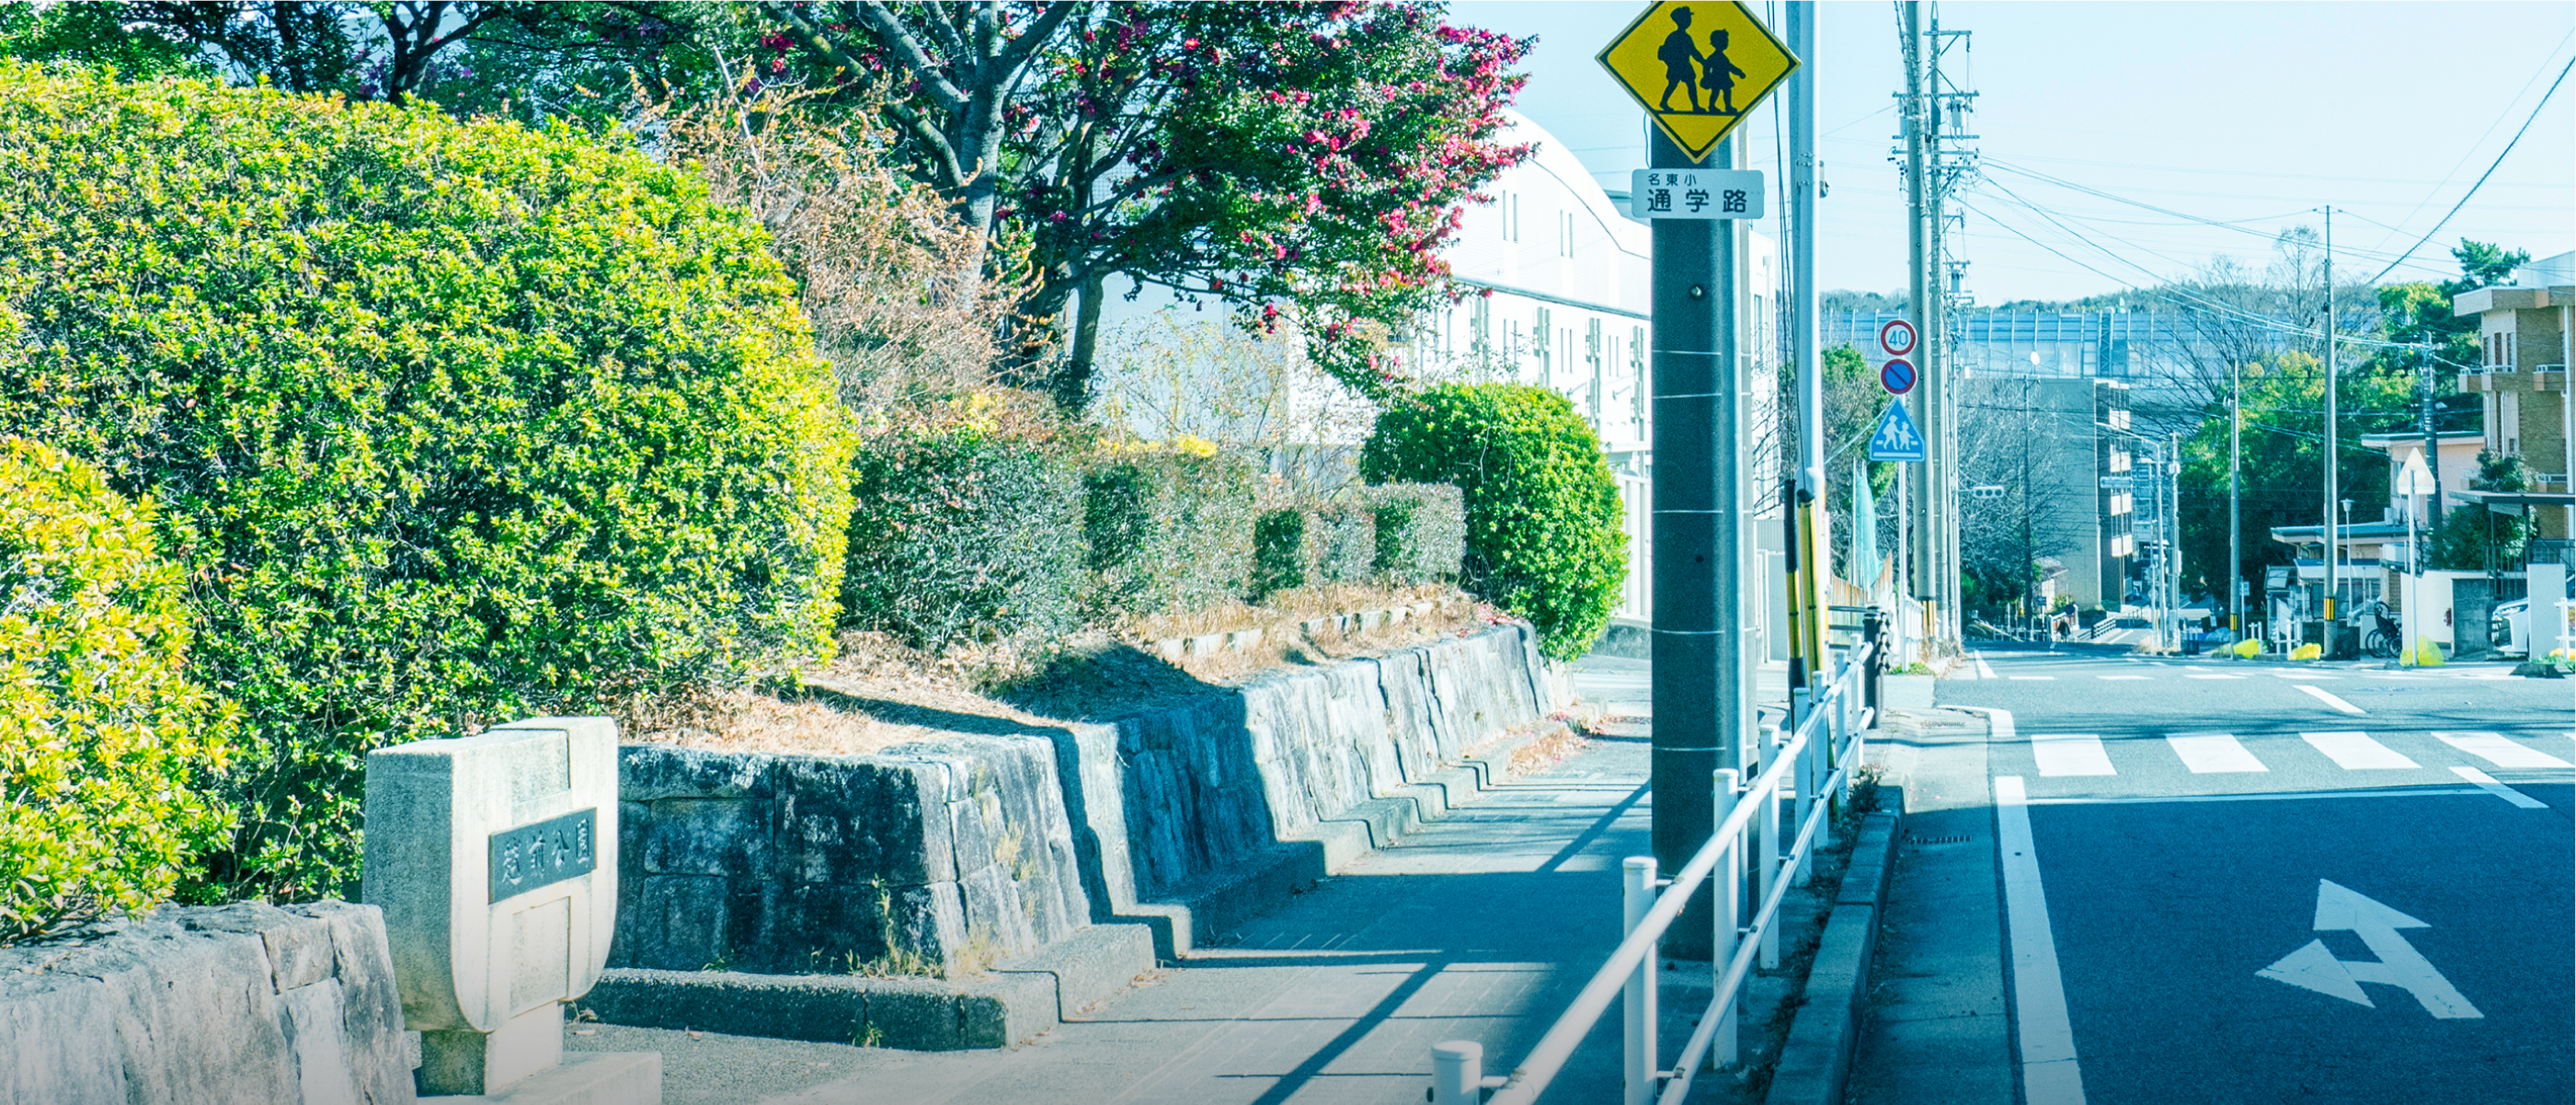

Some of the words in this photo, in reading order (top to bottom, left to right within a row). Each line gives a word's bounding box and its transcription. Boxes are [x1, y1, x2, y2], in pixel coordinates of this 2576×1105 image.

[1648, 173, 1697, 187] 名東小
[1647, 189, 1747, 213] 通学路
[1888, 329, 1909, 346] 40
